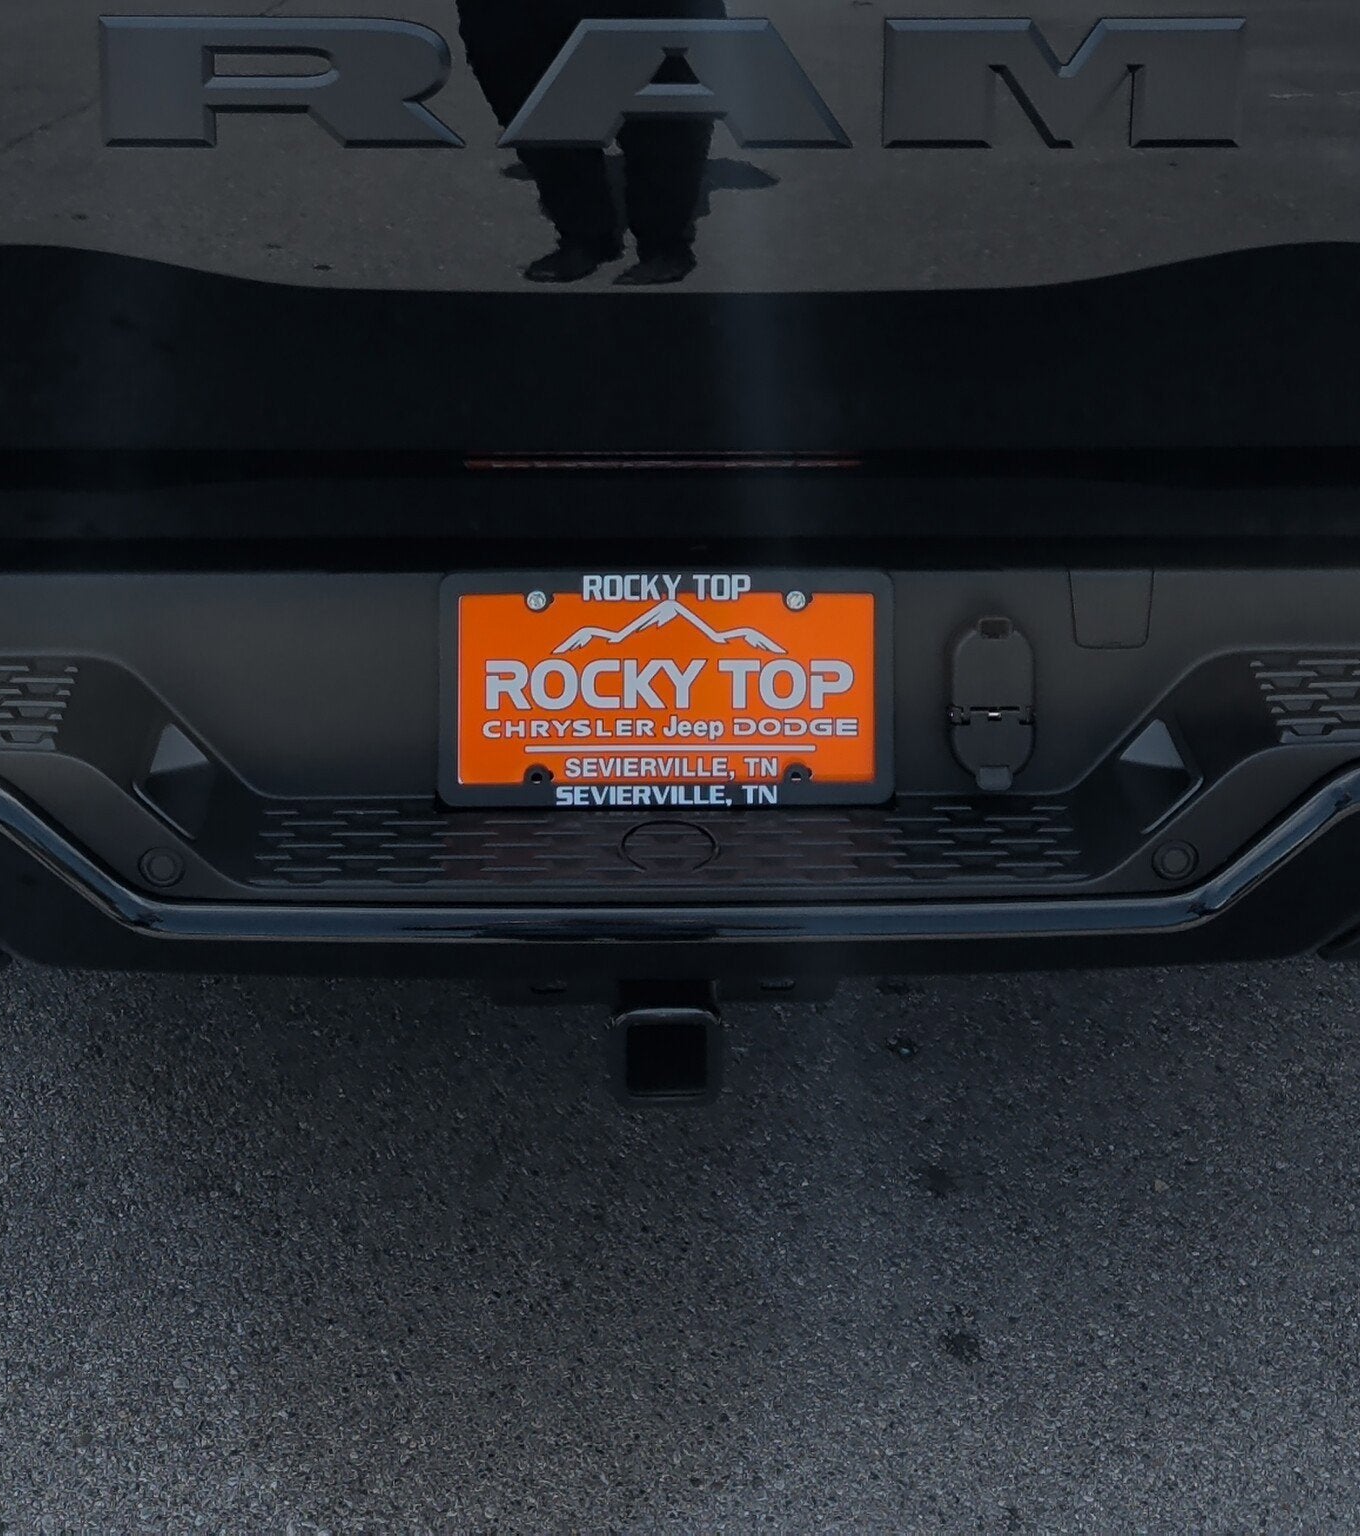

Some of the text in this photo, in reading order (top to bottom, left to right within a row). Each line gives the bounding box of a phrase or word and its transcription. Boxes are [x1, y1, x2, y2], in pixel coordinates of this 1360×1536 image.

[99, 15, 1246, 150] RAM
[582, 574, 751, 601] ROCKY TOP
[484, 659, 854, 710] ROCKY TOP
[482, 716, 858, 740] CHRYSLER Jeep DODGE
[565, 757, 778, 780] SEVIERVILLE, TN
[555, 785, 778, 806] SEVIERVILLE, TN
